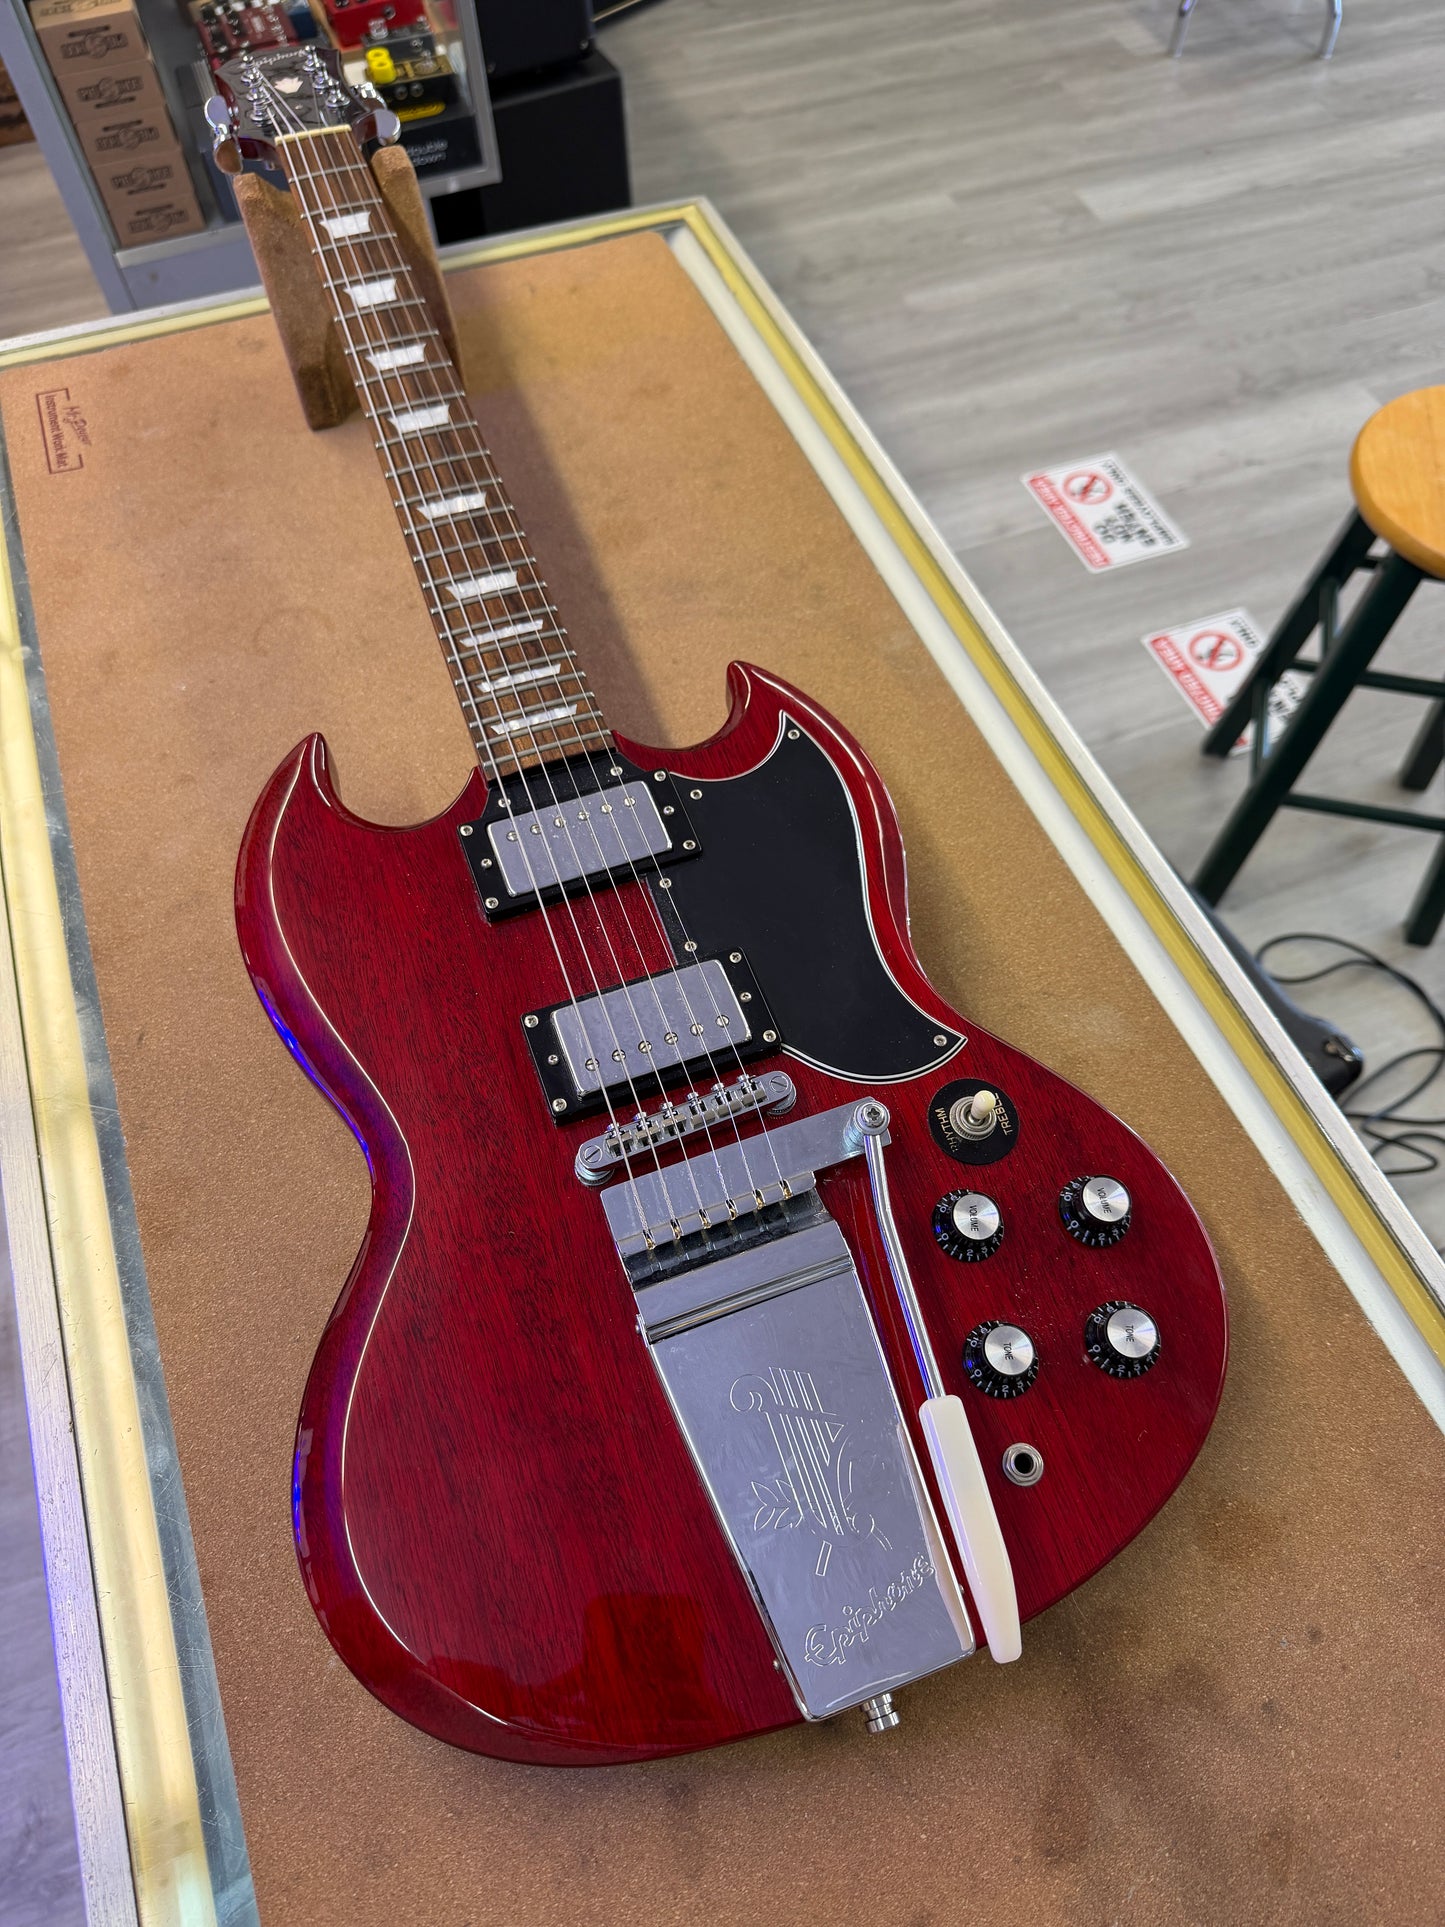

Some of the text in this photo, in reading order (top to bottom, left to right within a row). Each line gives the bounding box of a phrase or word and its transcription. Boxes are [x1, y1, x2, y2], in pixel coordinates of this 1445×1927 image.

[45, 394, 62, 433] Instrument
[52, 432, 66, 452] Work
[935, 1107, 958, 1152] RHYTHM
[1097, 1187, 1112, 1214] VOLUME
[969, 1205, 979, 1232] VOLUME
[1125, 1325, 1135, 1343] TONE
[1003, 1342, 1014, 1361] TONE
[804, 1551, 935, 1667] Epiphone
